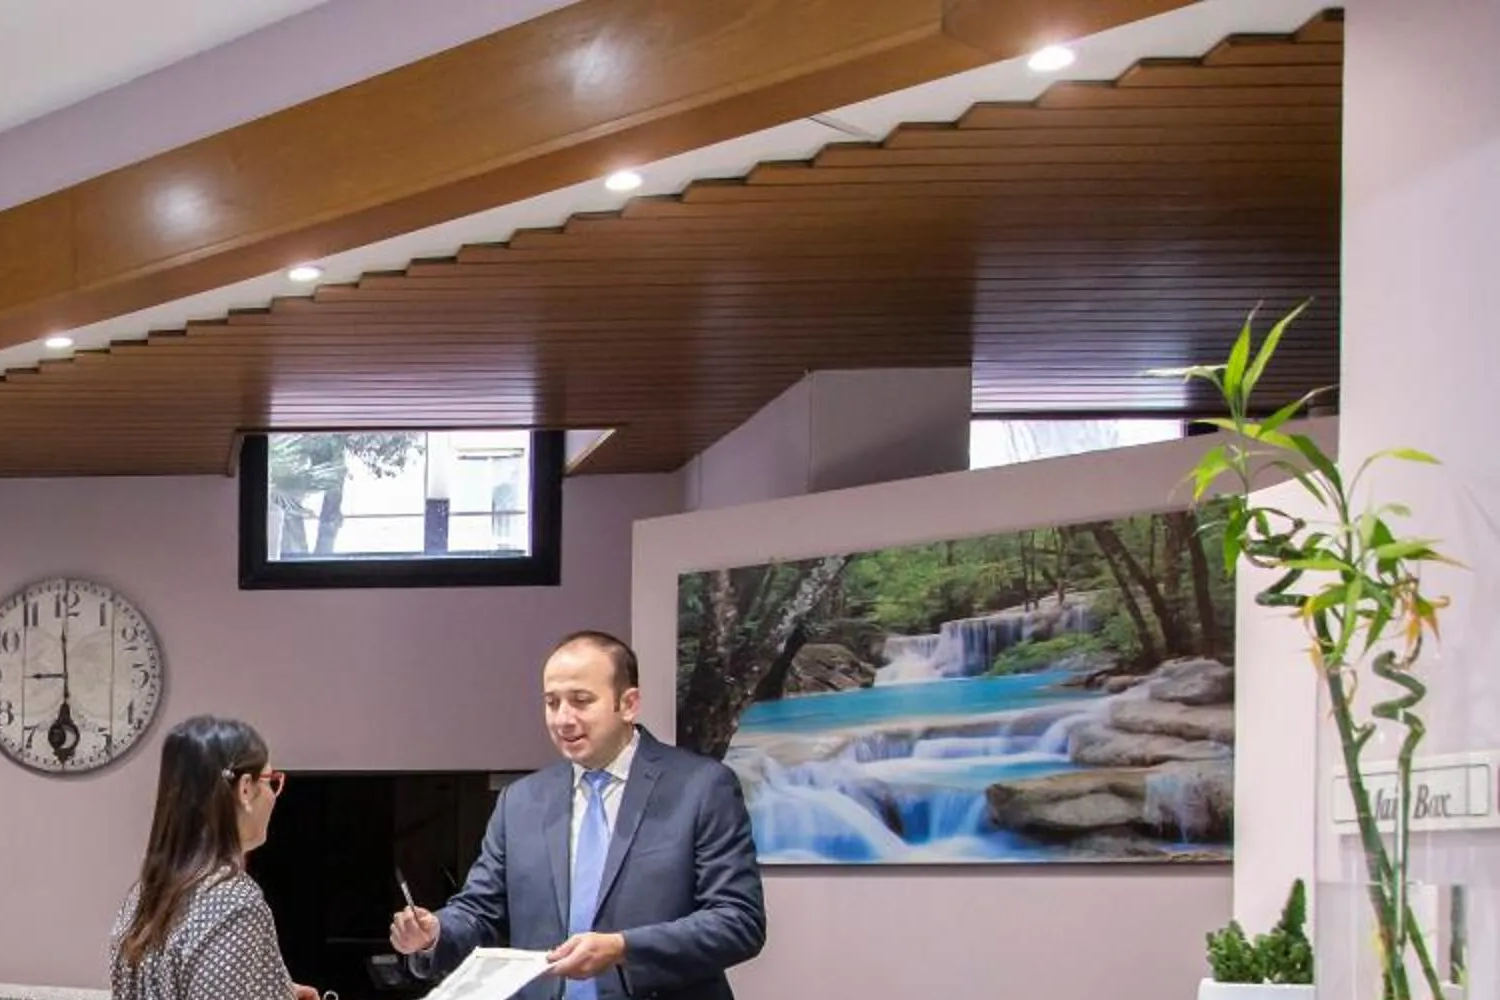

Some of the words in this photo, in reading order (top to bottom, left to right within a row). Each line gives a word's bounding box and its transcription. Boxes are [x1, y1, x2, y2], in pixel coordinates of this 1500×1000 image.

[22, 602, 39, 628] 11
[54, 591, 81, 619] 12
[99, 602, 107, 628] 1
[121, 627, 139, 652] 2
[22, 725, 39, 750] 7
